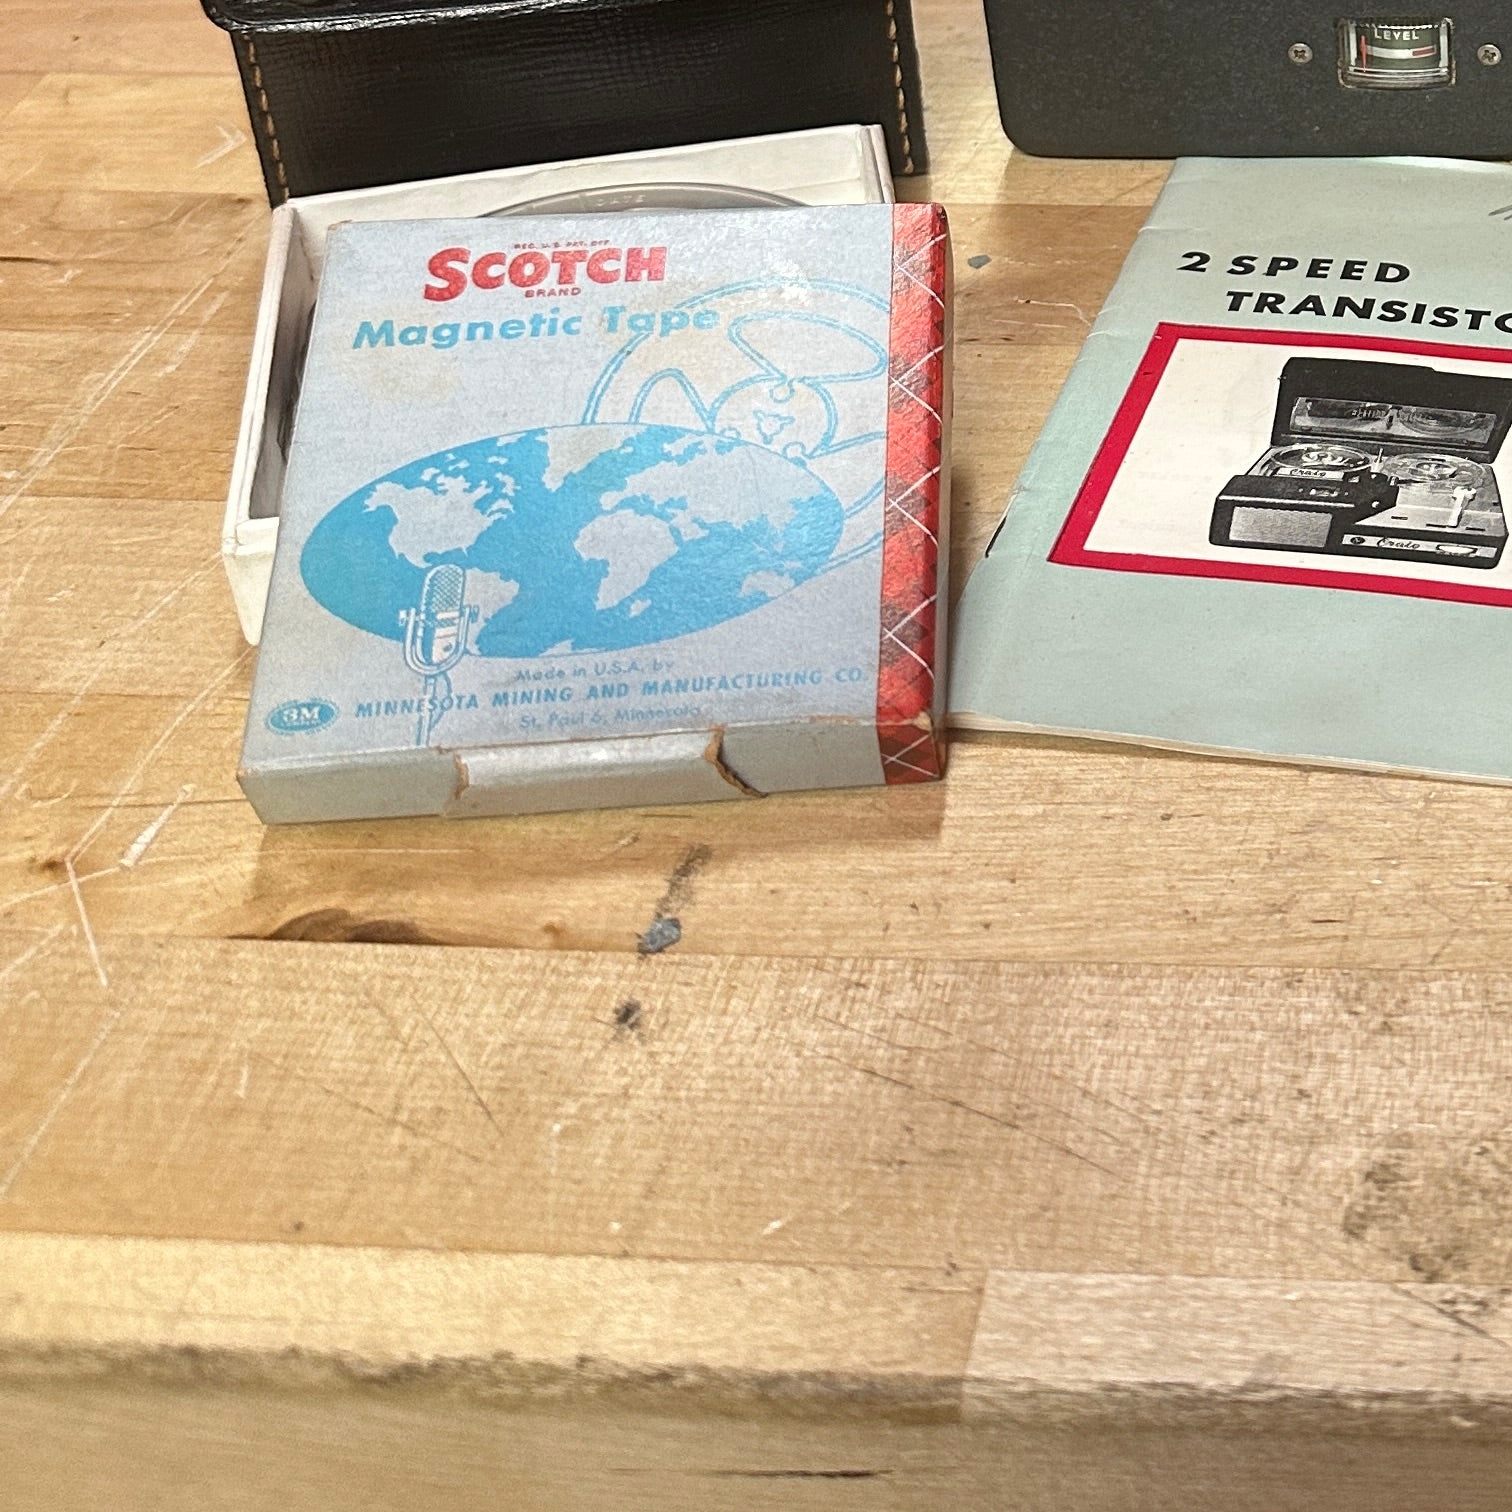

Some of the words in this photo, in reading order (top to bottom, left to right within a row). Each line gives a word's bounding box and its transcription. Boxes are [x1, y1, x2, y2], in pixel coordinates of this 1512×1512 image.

[1372, 28, 1420, 41] LEVEL
[423, 246, 668, 302] SCOTCH
[1176, 251, 1212, 273] 2
[1225, 255, 1411, 284] SPEED
[524, 287, 582, 299] BRAND
[352, 307, 583, 350] Magnetic
[604, 305, 720, 338] Tape
[515, 666, 566, 682] Made
[573, 663, 587, 677] in
[652, 658, 675, 672] by
[355, 694, 479, 717] MINNESOTA
[492, 686, 573, 707] MINING
[586, 682, 629, 700] AND
[641, 669, 822, 696] MANUFACTURING
[283, 704, 320, 723] 3M
[548, 711, 585, 729] Paul
